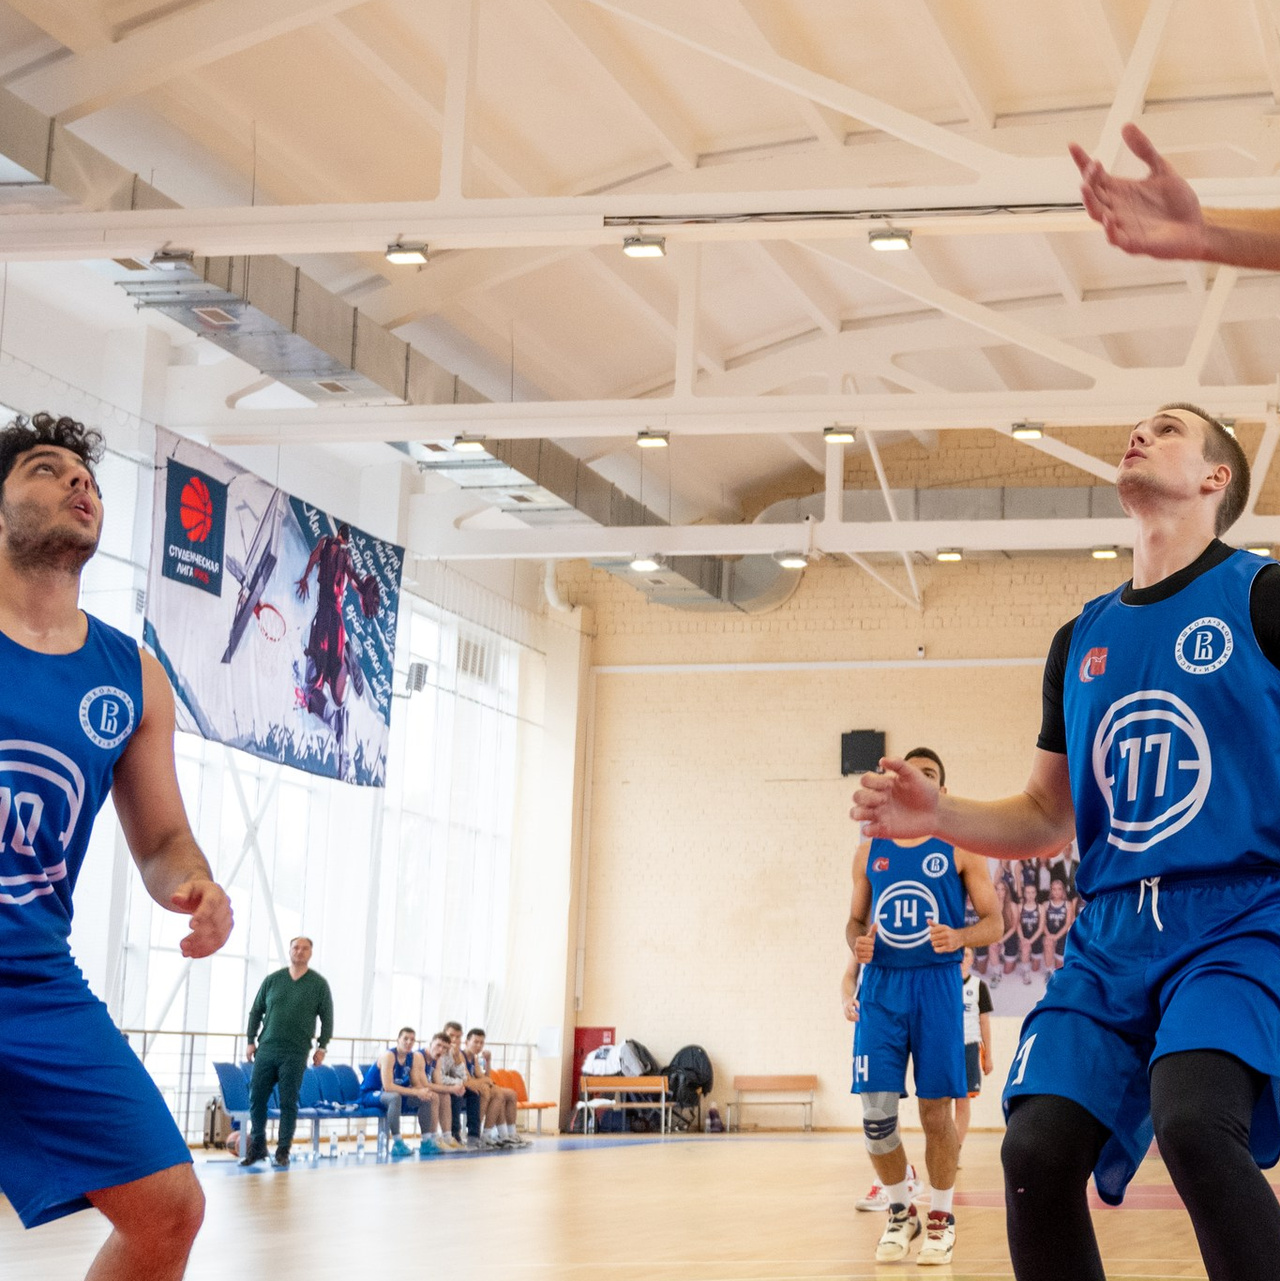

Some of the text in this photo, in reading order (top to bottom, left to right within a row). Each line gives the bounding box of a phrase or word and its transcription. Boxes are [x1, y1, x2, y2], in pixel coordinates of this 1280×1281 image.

[169, 544, 220, 574] СТУДЕНЧЕСКАЯ
[176, 563, 194, 578] ЛИГА
[1181, 619, 1212, 638] ШКОЛА
[1119, 732, 1172, 803] 77
[893, 899, 918, 928] 14
